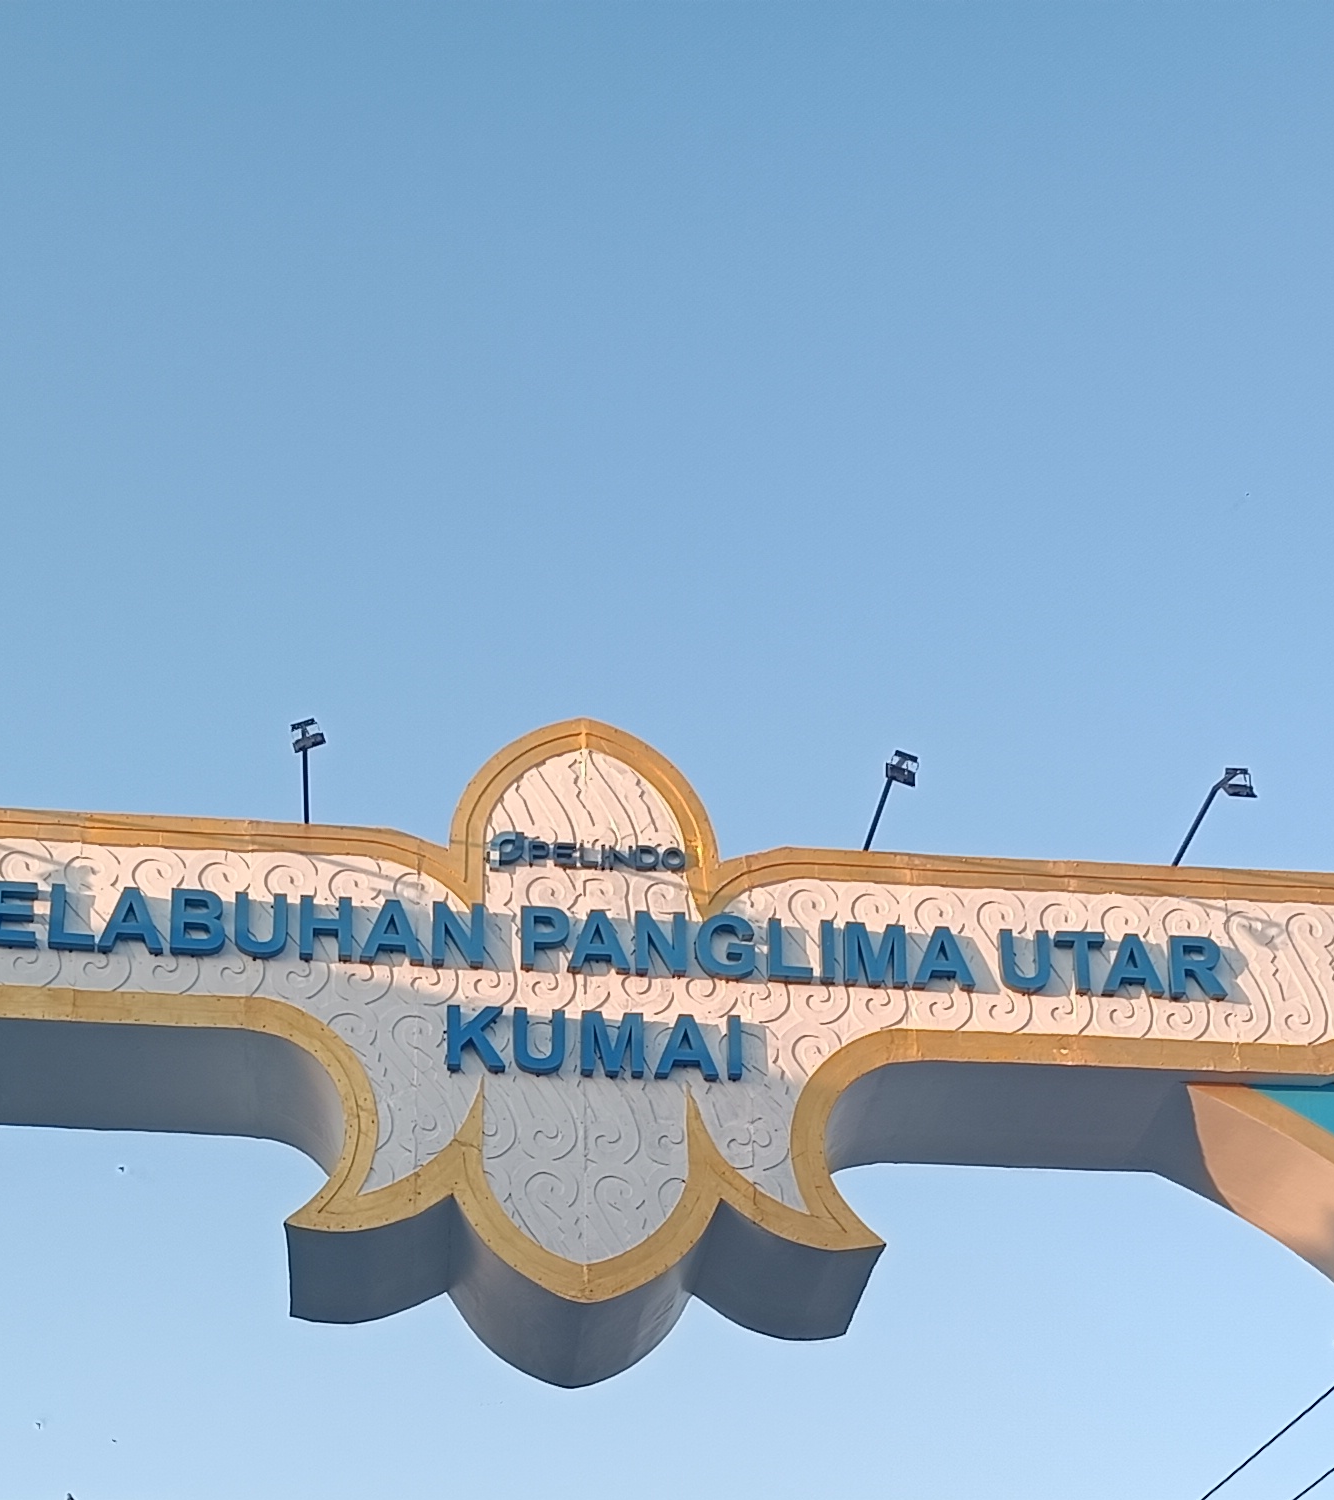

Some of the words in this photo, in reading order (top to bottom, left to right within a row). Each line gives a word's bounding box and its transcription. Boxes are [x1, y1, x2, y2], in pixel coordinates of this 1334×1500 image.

[528, 839, 686, 872] PELINDO
[520, 904, 976, 991] PANGLIMA
[997, 927, 1229, 1000] UTAR
[444, 1003, 743, 1082] KUMAI
